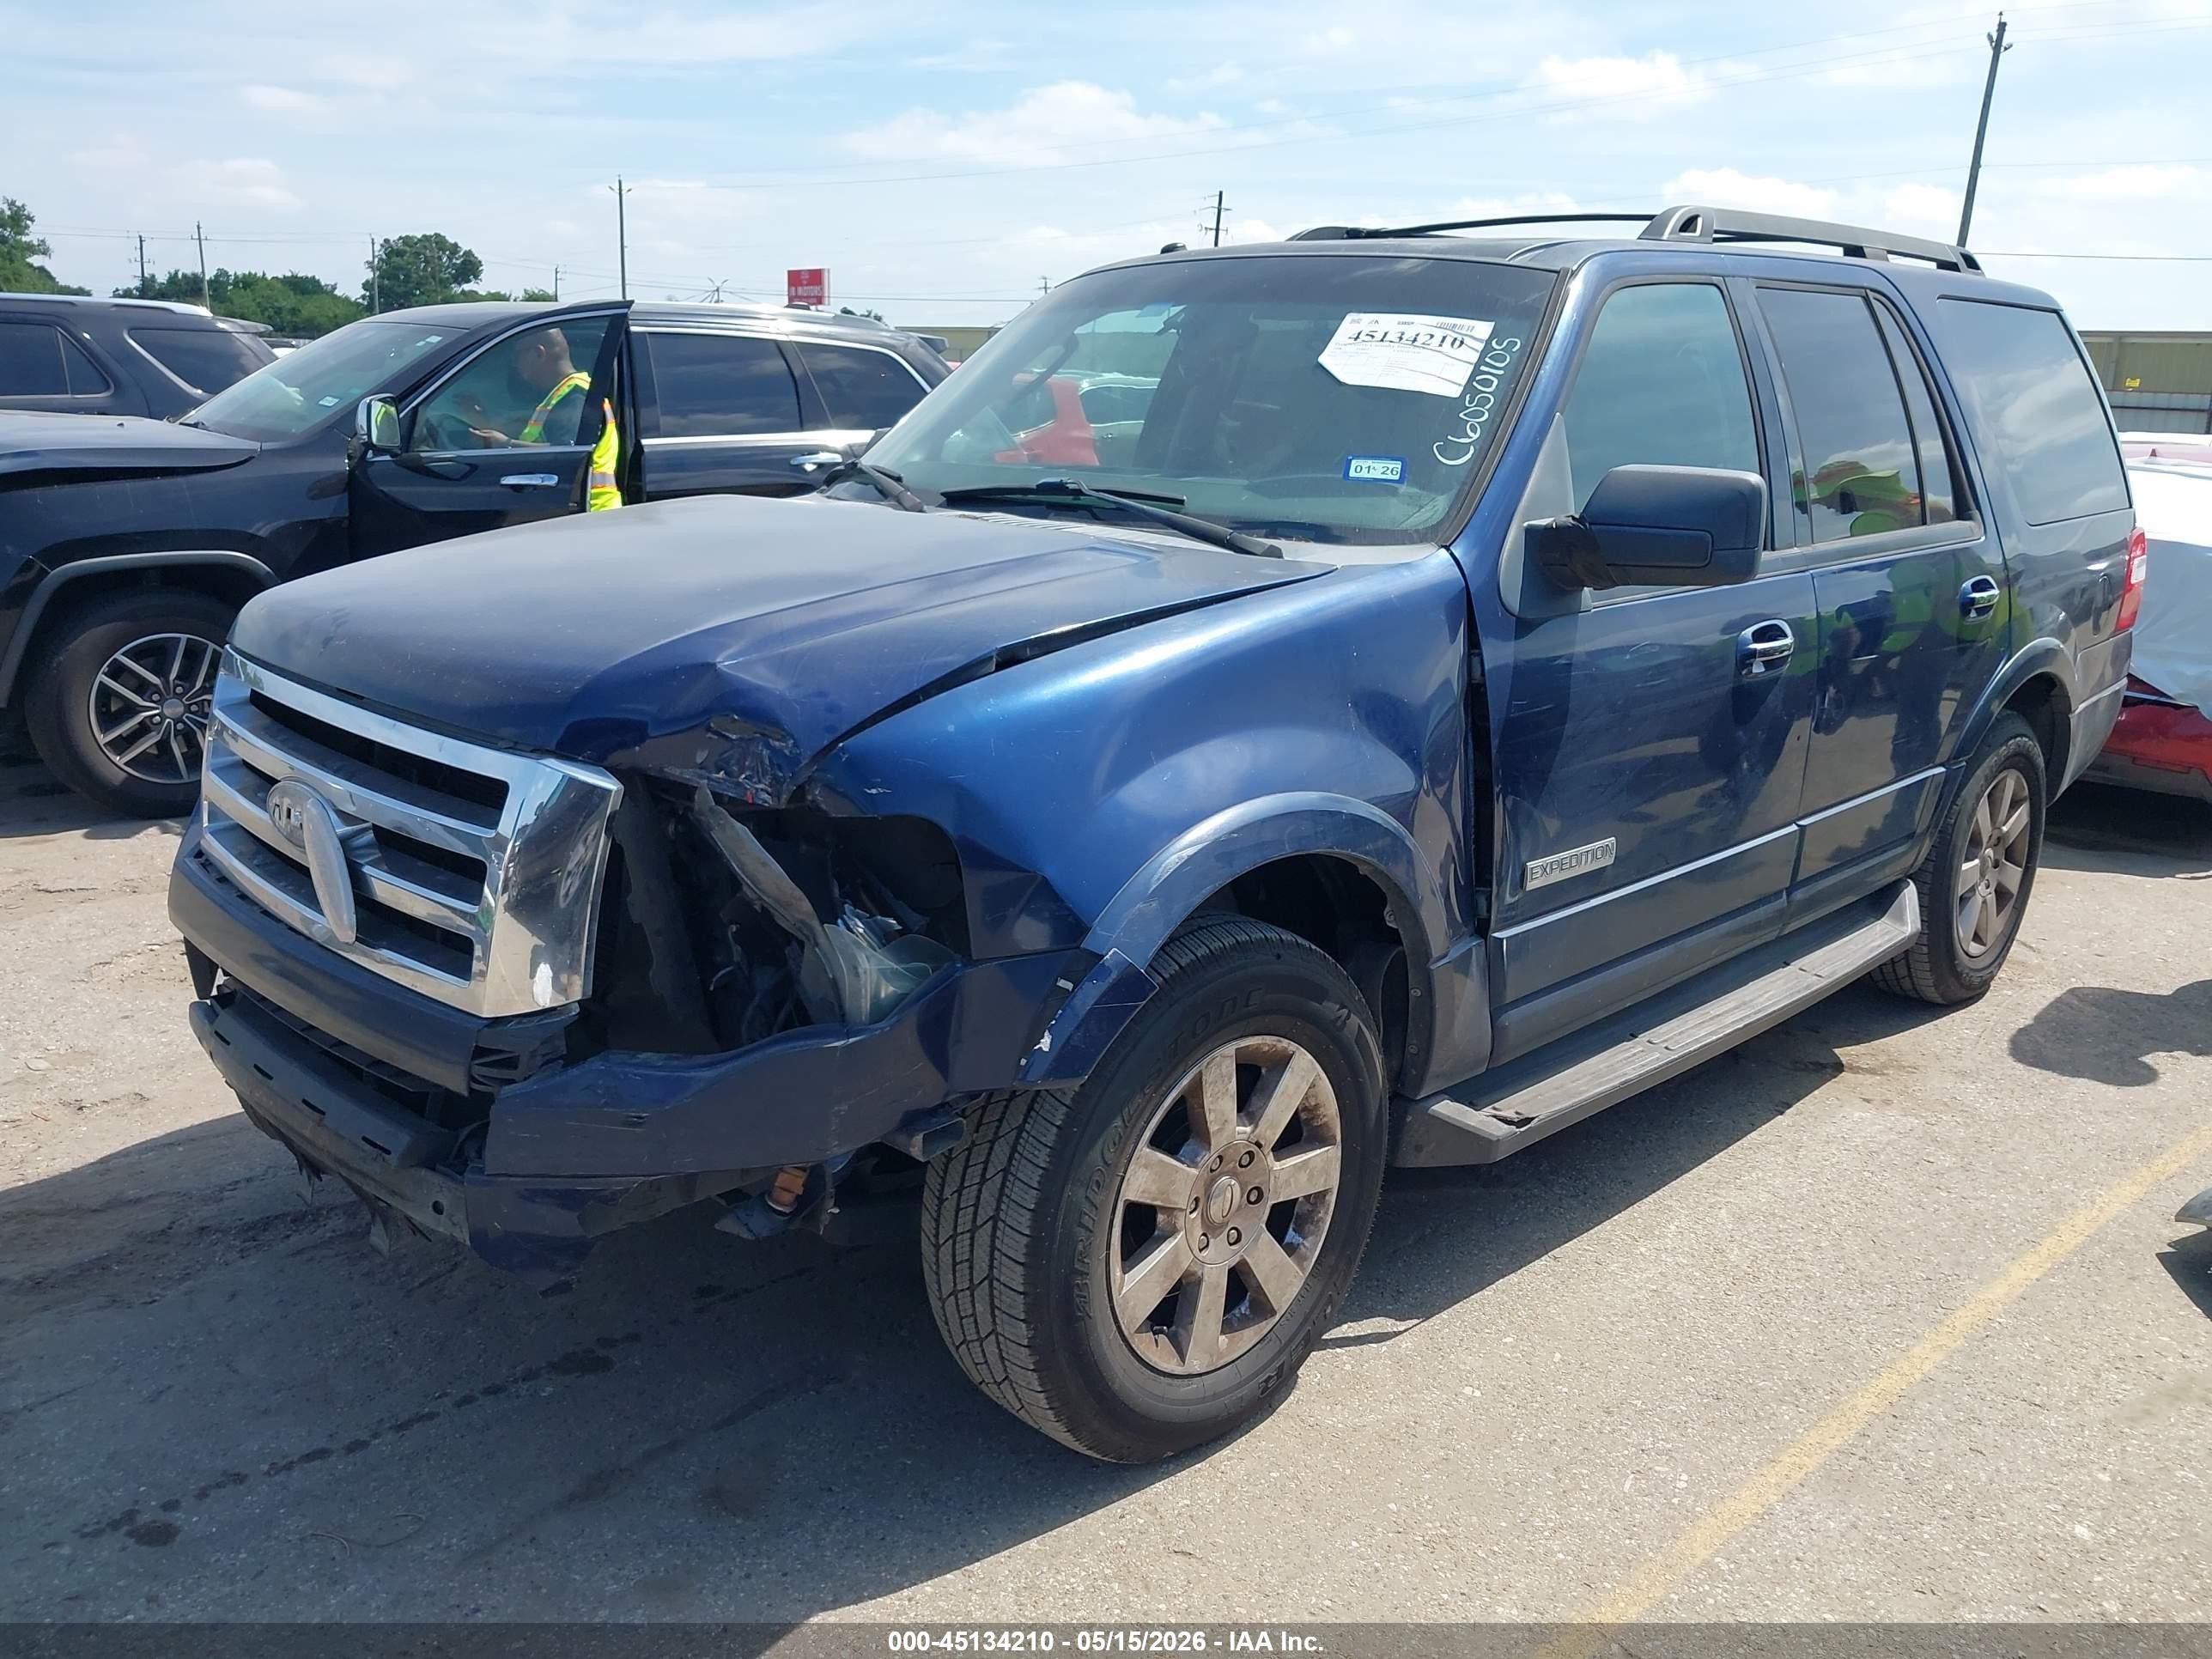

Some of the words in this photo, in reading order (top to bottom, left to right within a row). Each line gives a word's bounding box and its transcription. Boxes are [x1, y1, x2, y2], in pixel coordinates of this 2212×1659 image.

[1347, 329, 1465, 349] 45134210
[1353, 464, 1371, 475] 01
[1380, 465, 1400, 476] 26
[1528, 841, 1615, 882] EXPEDITION
